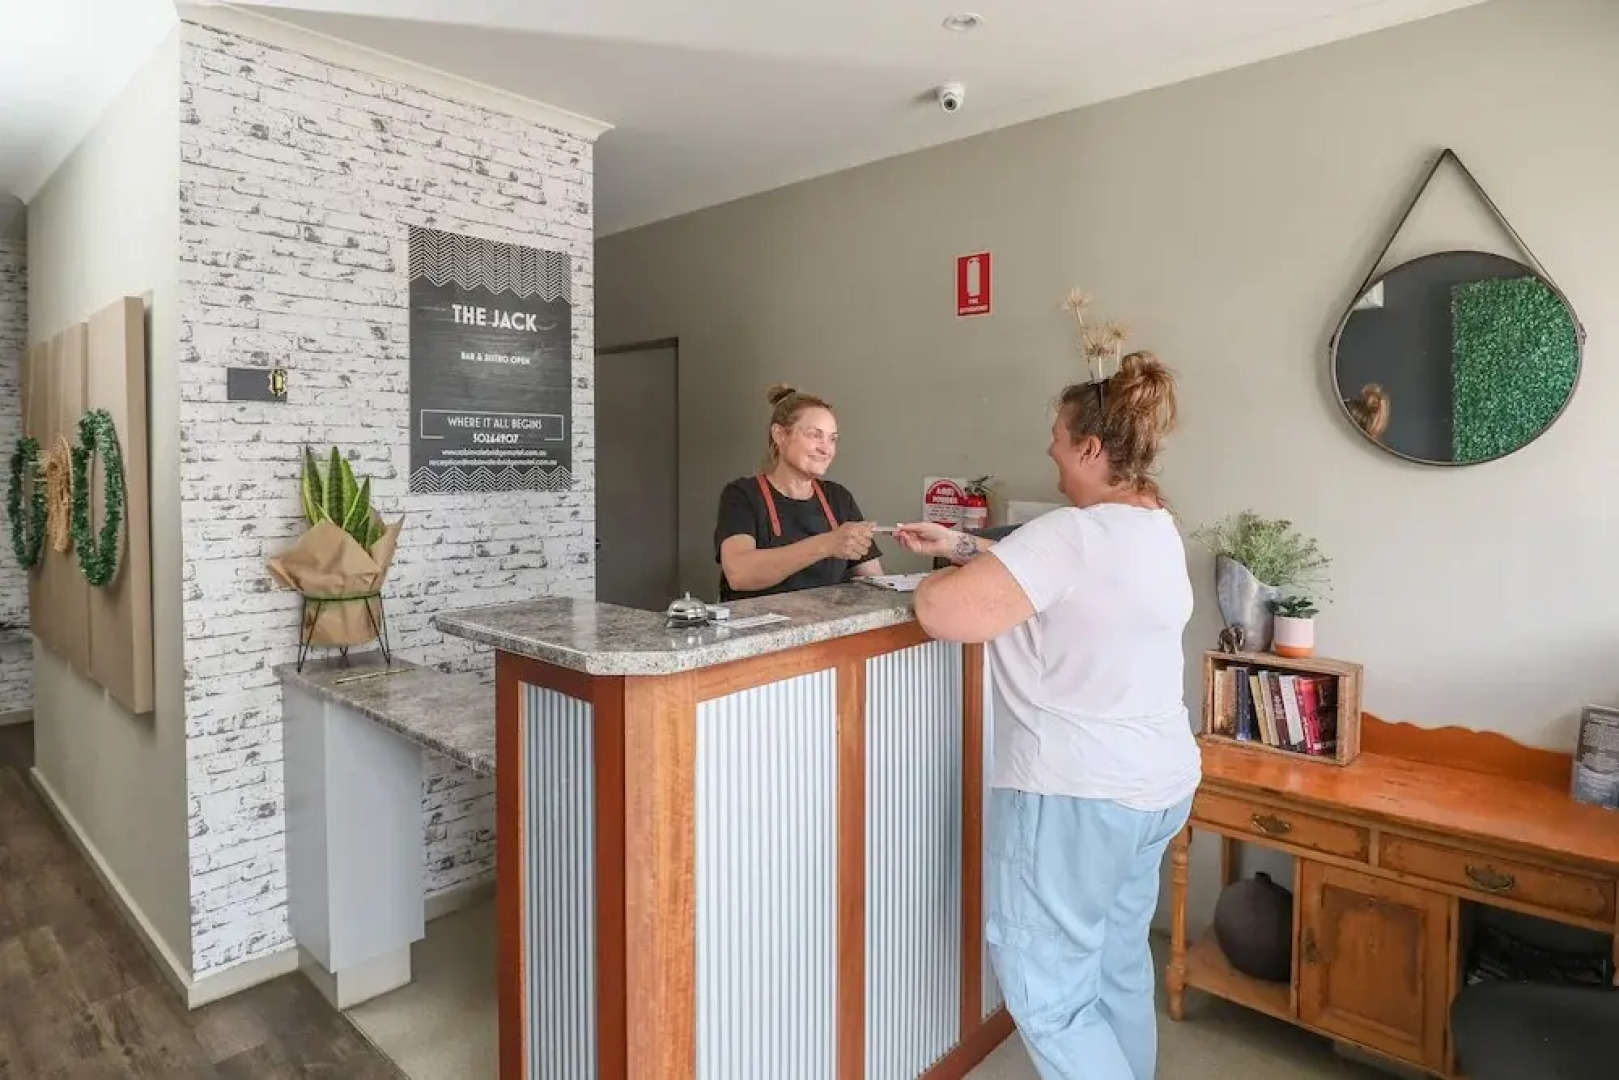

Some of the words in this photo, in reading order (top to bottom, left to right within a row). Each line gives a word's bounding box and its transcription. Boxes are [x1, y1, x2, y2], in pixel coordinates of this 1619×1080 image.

[451, 304, 487, 326] THE
[491, 308, 538, 332] JACK
[461, 351, 475, 361] BAR
[484, 352, 508, 364] BISTRO
[509, 355, 530, 365] OPEN
[447, 416, 481, 428] WHERE
[483, 417, 491, 428] IT
[493, 417, 510, 428] ALL
[512, 418, 543, 430] BEGINS
